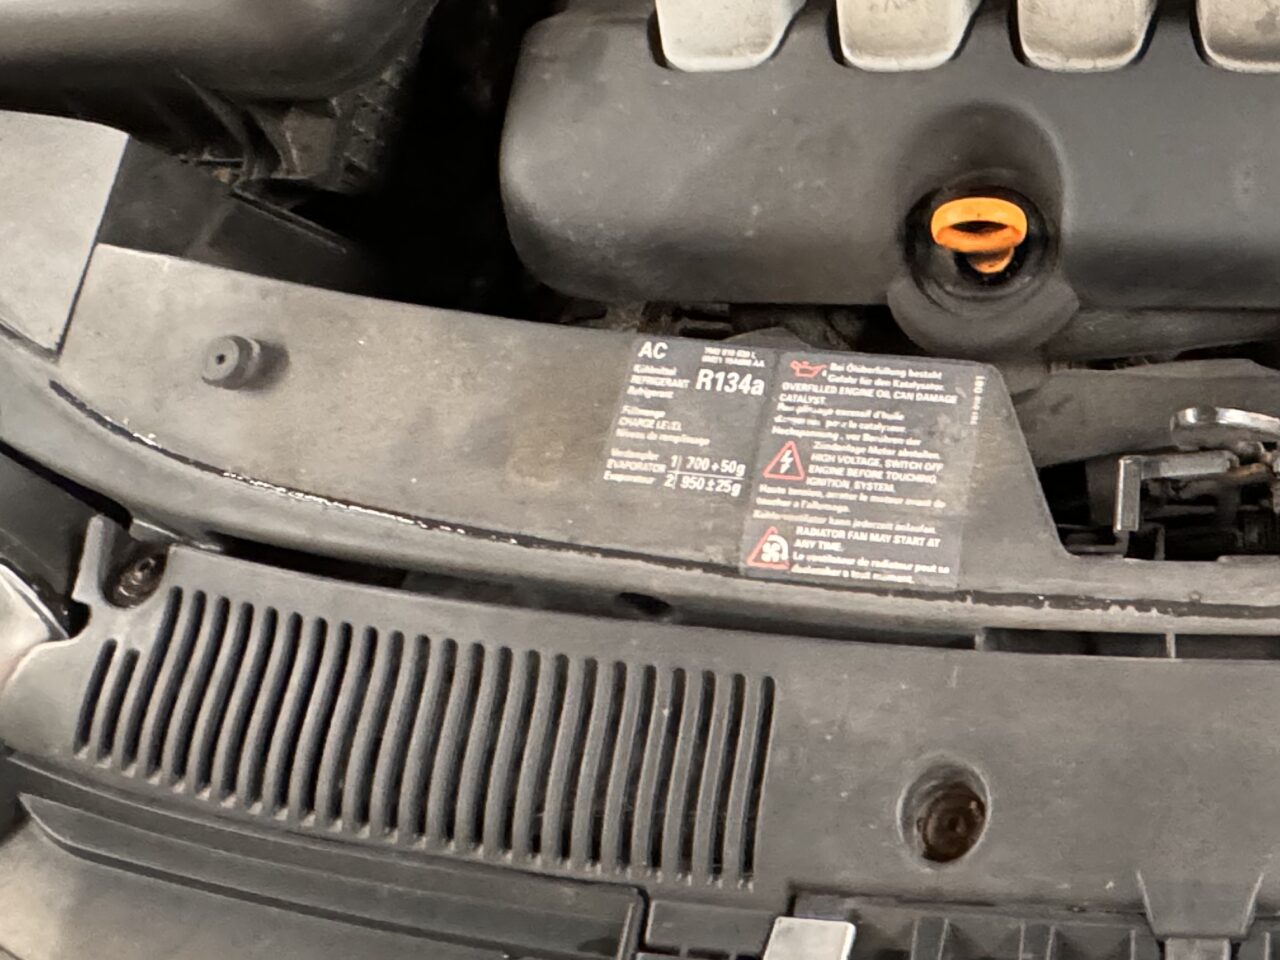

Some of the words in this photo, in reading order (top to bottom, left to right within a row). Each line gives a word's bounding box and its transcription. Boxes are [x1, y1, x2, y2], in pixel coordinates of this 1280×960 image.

[637, 341, 669, 359] AC
[695, 369, 765, 396] R134a
[781, 382, 838, 396] OVERFILLED
[839, 385, 875, 398] ENGINE
[893, 389, 914, 401] CAN
[915, 392, 958, 405] DAMAGE
[671, 454, 678, 468] 1
[685, 455, 710, 471] 700
[810, 453, 836, 464] HIGH
[884, 460, 923, 471] SWITCH
[924, 463, 945, 474] OFF
[808, 465, 845, 476] ENGINE
[847, 467, 884, 479] BEFORE
[664, 473, 674, 487] 2
[680, 475, 705, 490] 950
[794, 539, 815, 549] ANY
[796, 526, 846, 540] RADIATOR
[847, 530, 869, 541] FAN
[869, 533, 892, 543] MAY
[893, 535, 926, 547] START
[927, 538, 941, 548] AT
